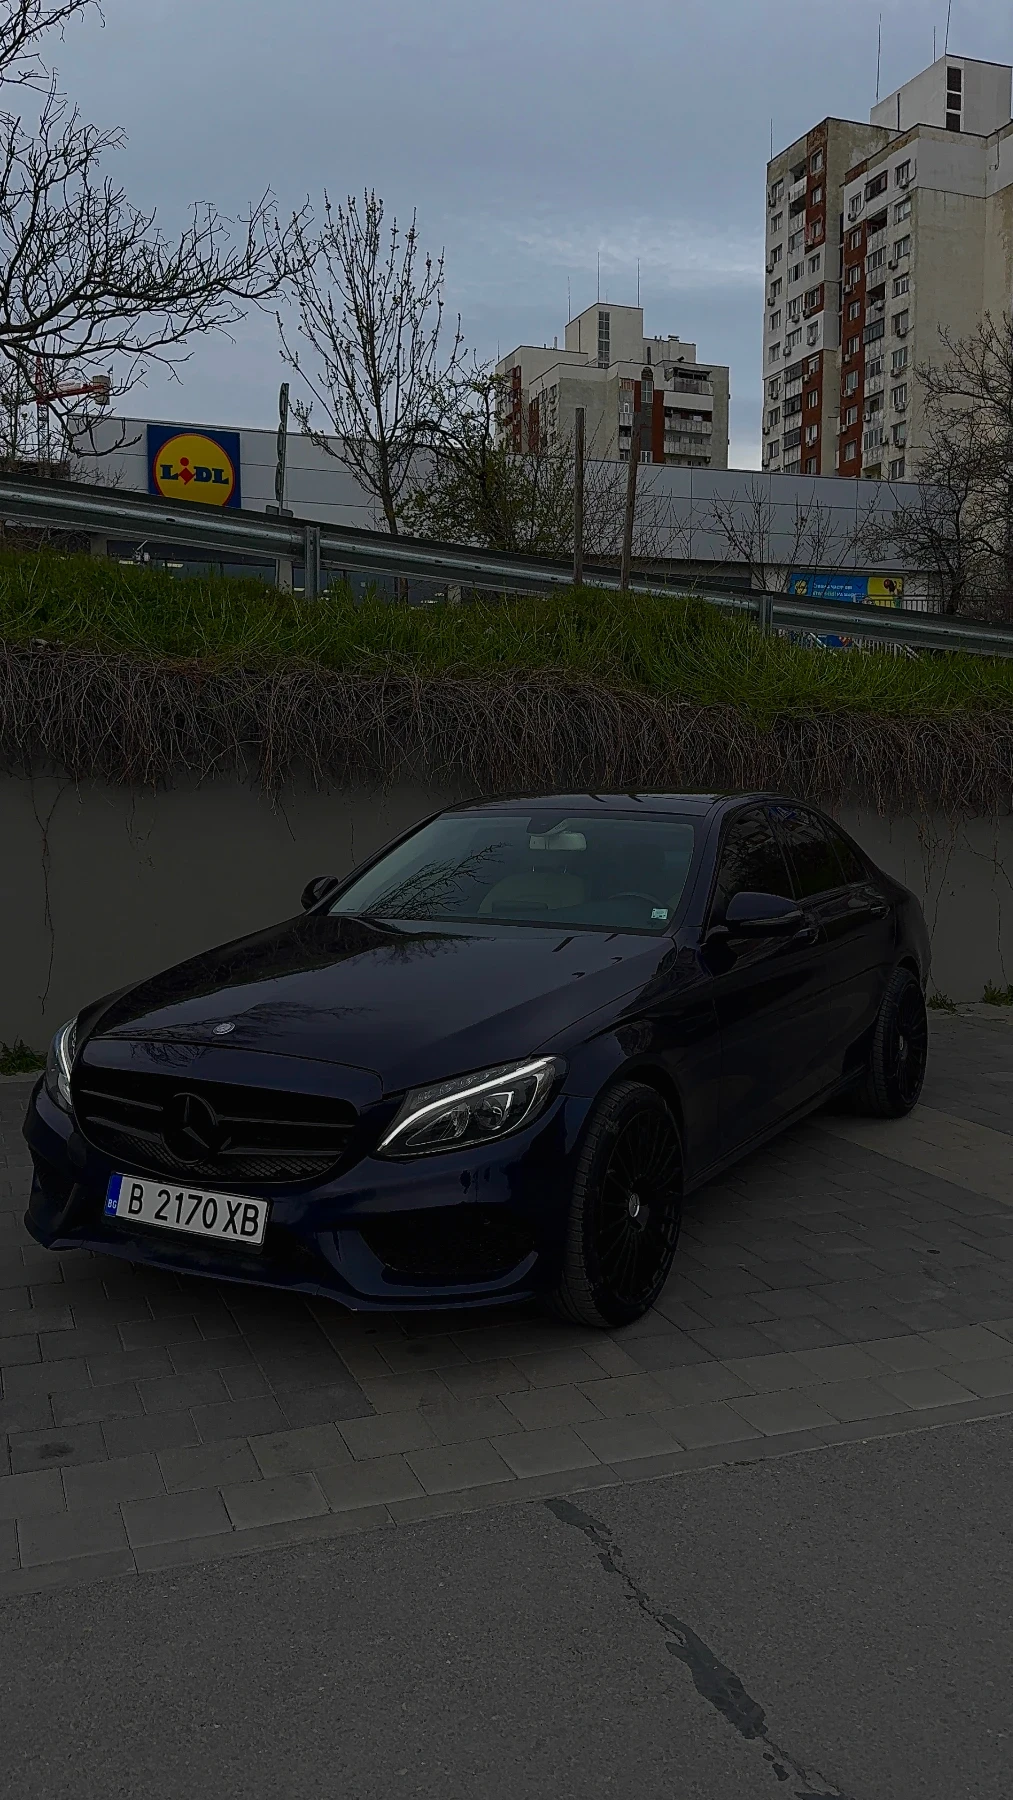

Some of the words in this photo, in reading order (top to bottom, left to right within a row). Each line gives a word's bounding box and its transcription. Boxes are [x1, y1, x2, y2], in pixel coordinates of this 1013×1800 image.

[107, 1199, 118, 1209] BG
[128, 1183, 144, 1215] B
[154, 1189, 218, 1229] 2170
[222, 1200, 260, 1237] XB
